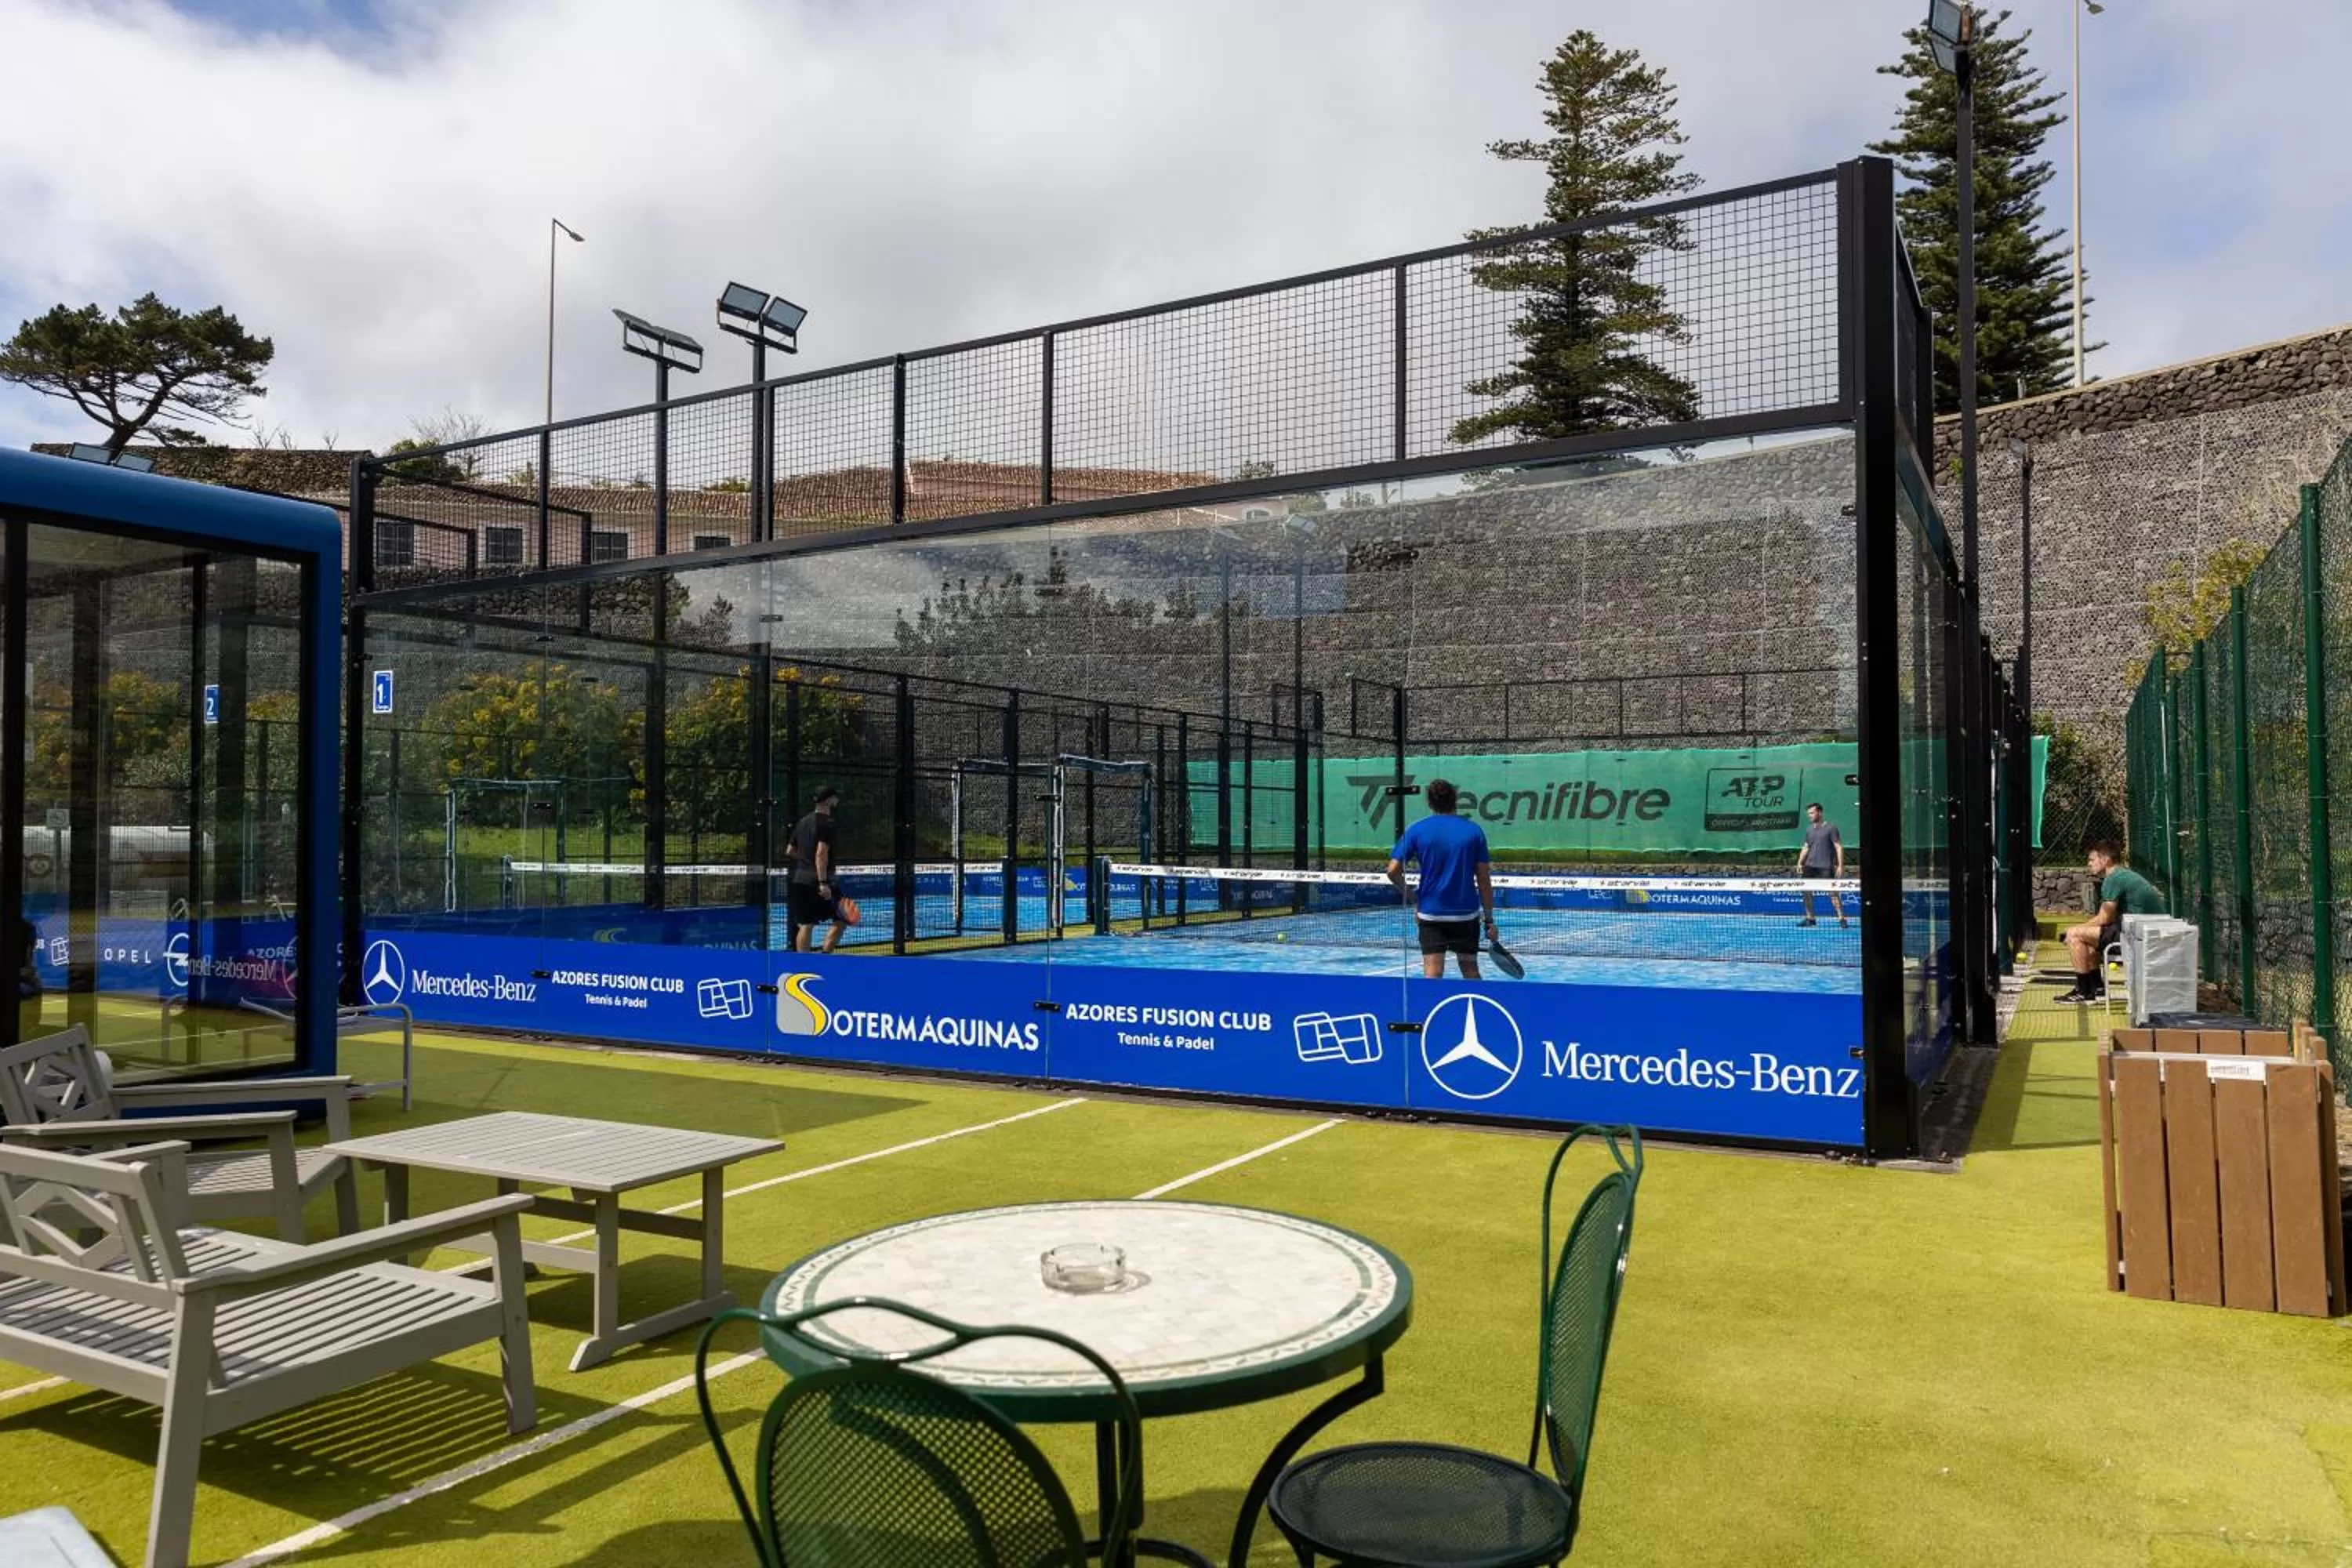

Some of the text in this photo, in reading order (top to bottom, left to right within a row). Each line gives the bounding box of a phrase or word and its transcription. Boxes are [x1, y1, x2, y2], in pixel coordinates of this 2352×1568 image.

[377, 683, 383, 703] 1
[206, 697, 214, 716] 2
[1720, 775, 1785, 797] ATP
[1456, 781, 1671, 821] ecnifibre
[1744, 796, 1784, 808] TOUR
[103, 947, 151, 964] OPEL
[247, 946, 297, 958] AZORE
[412, 969, 536, 1002] Mercedes-Benz
[552, 970, 684, 993] AZORES FUSION CLUB
[585, 993, 648, 1009] Tennis & Padel
[1065, 1003, 1272, 1032] AZORES FUSION CLUB
[1117, 1032, 1214, 1051] Tennis & Padel
[1542, 1040, 1860, 1098] Mercedes-Benz
